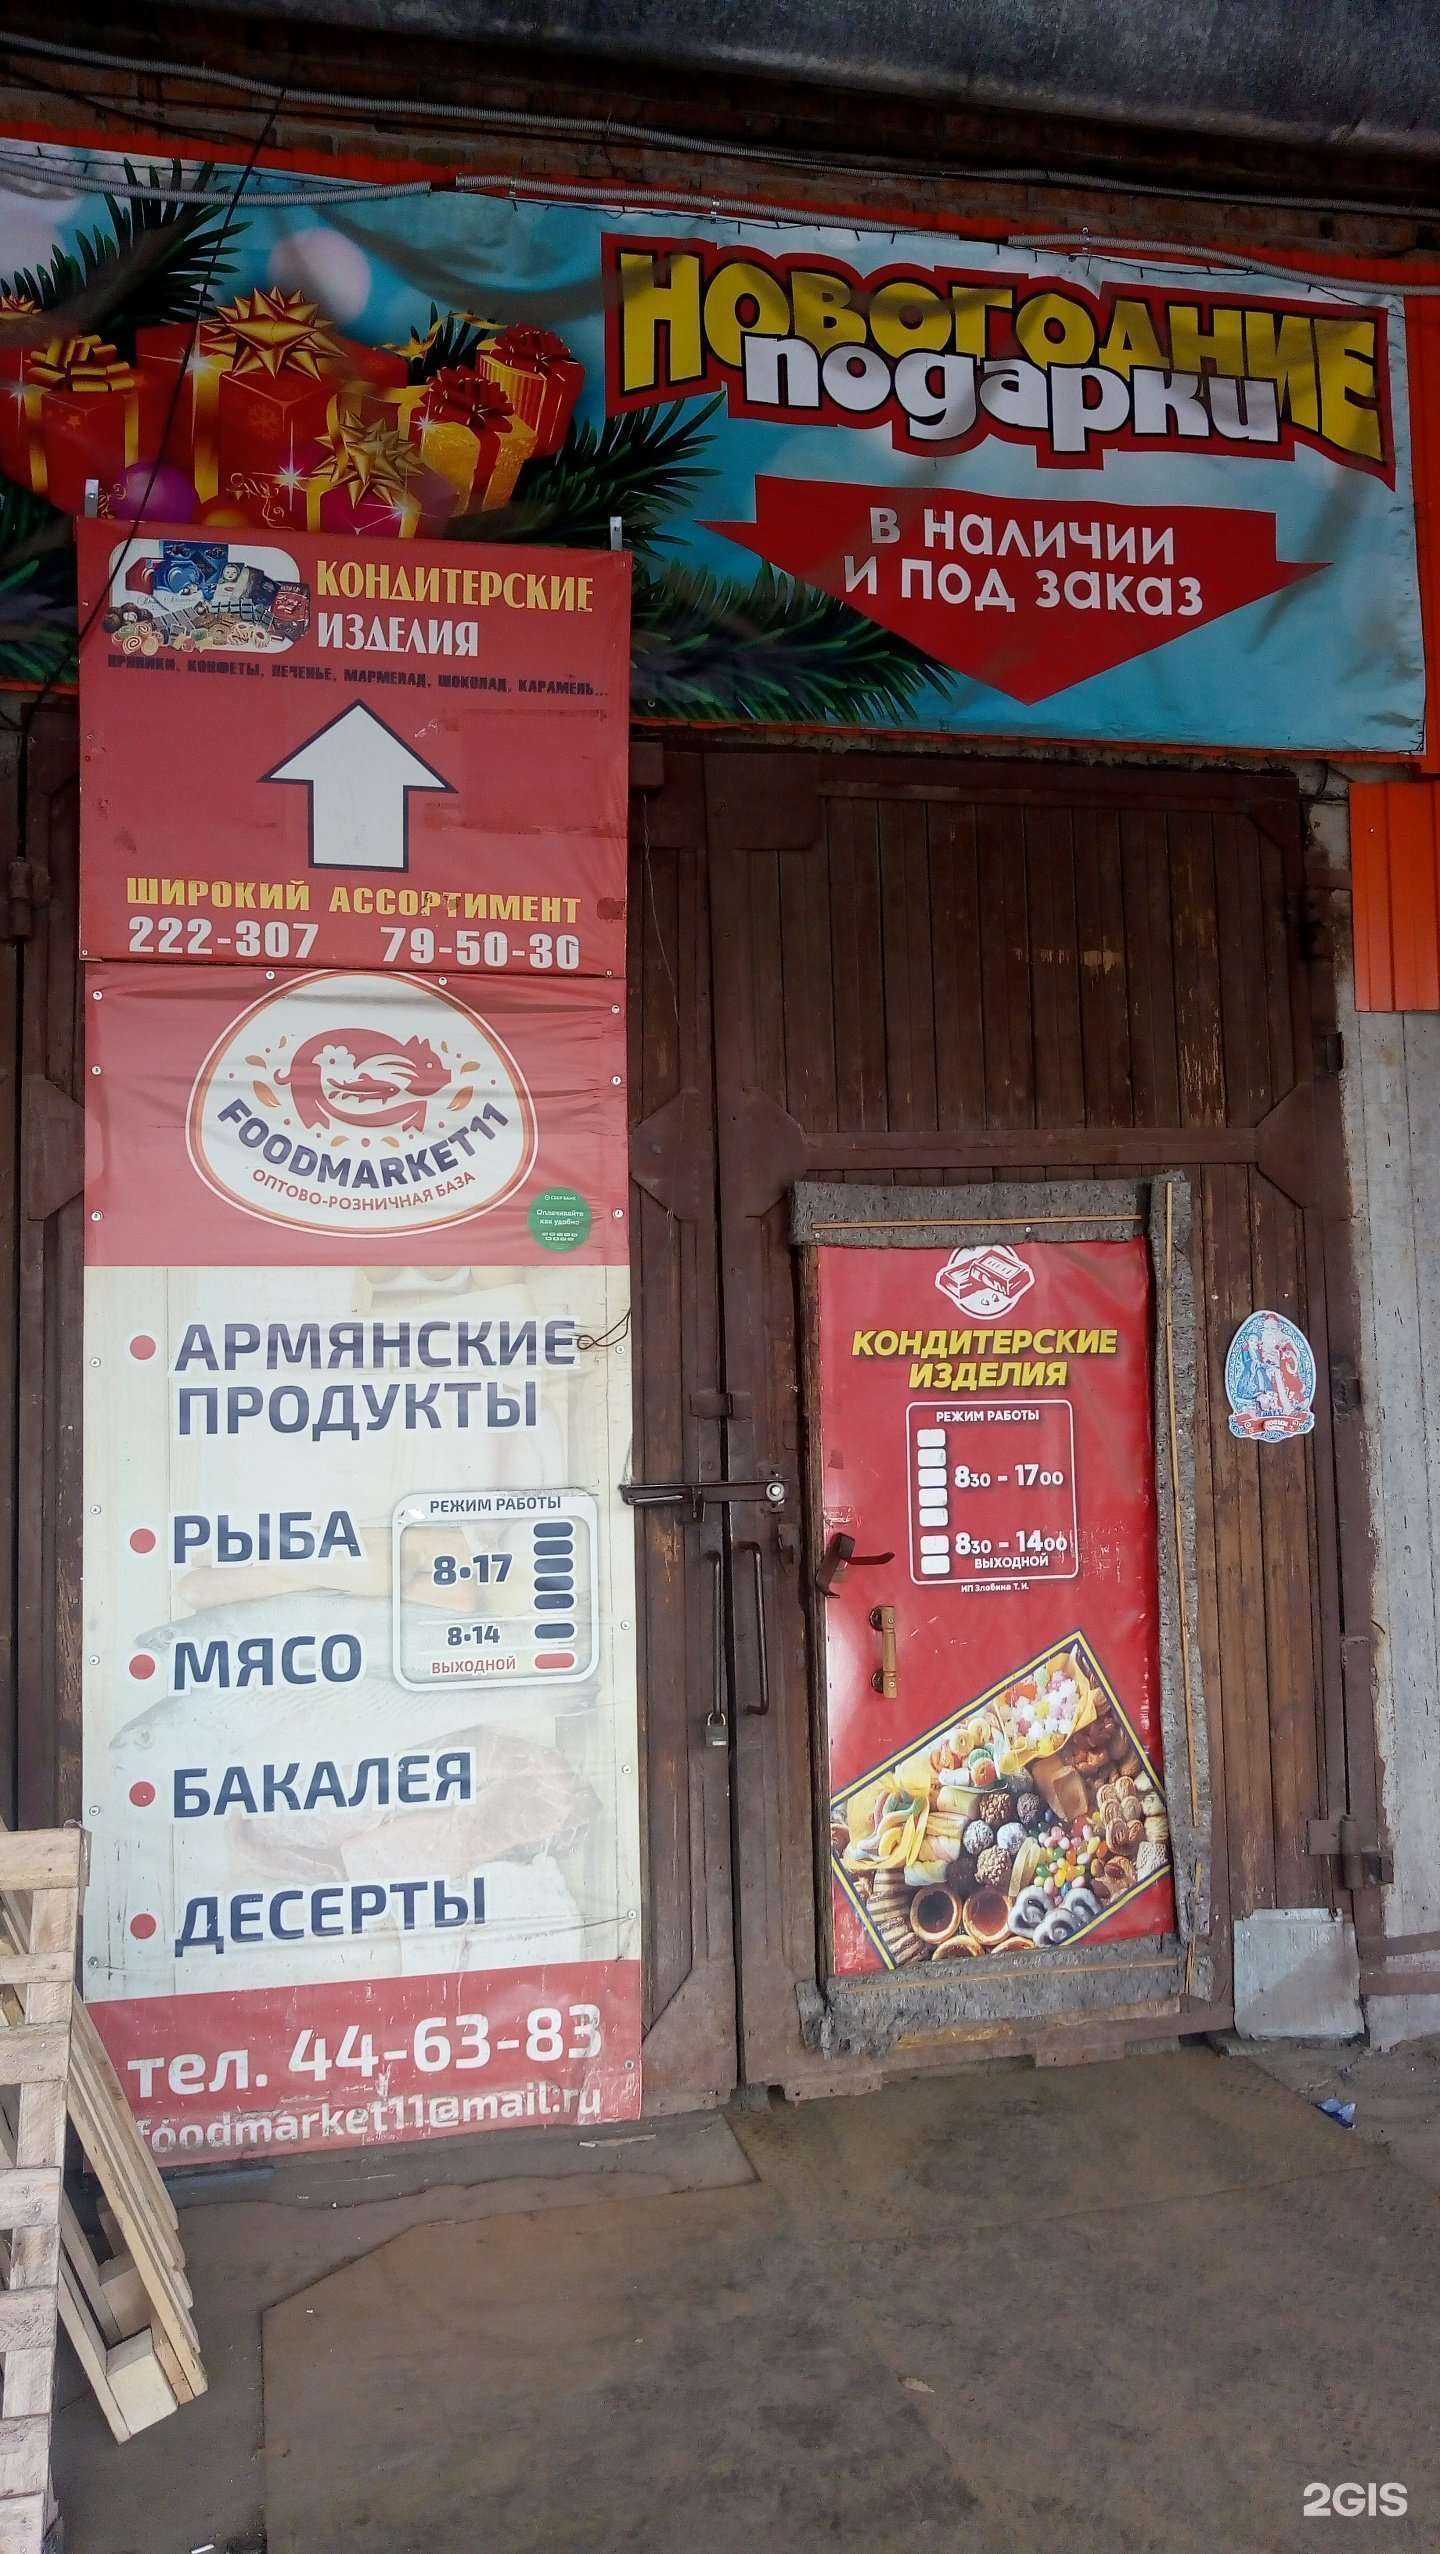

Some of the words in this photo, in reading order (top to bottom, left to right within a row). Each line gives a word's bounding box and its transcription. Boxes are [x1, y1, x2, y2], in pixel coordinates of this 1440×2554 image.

[744, 335, 1279, 454] подарки
[316, 560, 593, 612] КОНДИТЕРСКИЕ
[317, 612, 478, 656] ИЗДЕЛИЯ
[187, 659, 264, 677] КОНФЕТЫ,
[344, 669, 431, 688] МАРМЕЛАД,
[438, 674, 511, 693] ШОКОЛАД,
[126, 877, 310, 912] ШИРОКИЙ
[329, 886, 581, 924] АССОРТИМЕНТ
[128, 916, 319, 958] 222-307
[380, 926, 580, 969] 79-50-30
[217, 1098, 509, 1189] FOODMARKET11
[252, 1169, 433, 1211] ОПТОВО-РОЗНИЧНАЯ
[436, 1171, 476, 1198] БАЗА
[174, 1320, 576, 1371] АРМЯНСКИЕ
[852, 1328, 1118, 1357] КОНДИТЕРСКИЕ
[908, 1361, 1068, 1390] ИЗДЕЛИЯ
[179, 1381, 538, 1442] ПРОДУКТЫ
[936, 1411, 984, 1422] РЕЖИМ
[988, 1410, 1039, 1421] РАБОТЫ
[430, 1498, 491, 1513] РЕЖИМ
[496, 1496, 561, 1511] РАБОТЫ
[173, 1510, 362, 1564] РЫБА
[974, 1554, 1049, 1569] ВЫХОДНОЙ
[961, 1584, 974, 1593] ИП
[975, 1583, 1012, 1593] Злобина
[173, 1633, 362, 1690] МЯСО
[431, 1656, 516, 1674] ВЫХОДНОЙ
[173, 1752, 472, 1818] БАКАЛЕЯ
[174, 1876, 486, 1957] ДЕСЕРТЫ
[127, 2049, 268, 2098] тел.
[288, 2004, 602, 2082] 44-63-83
